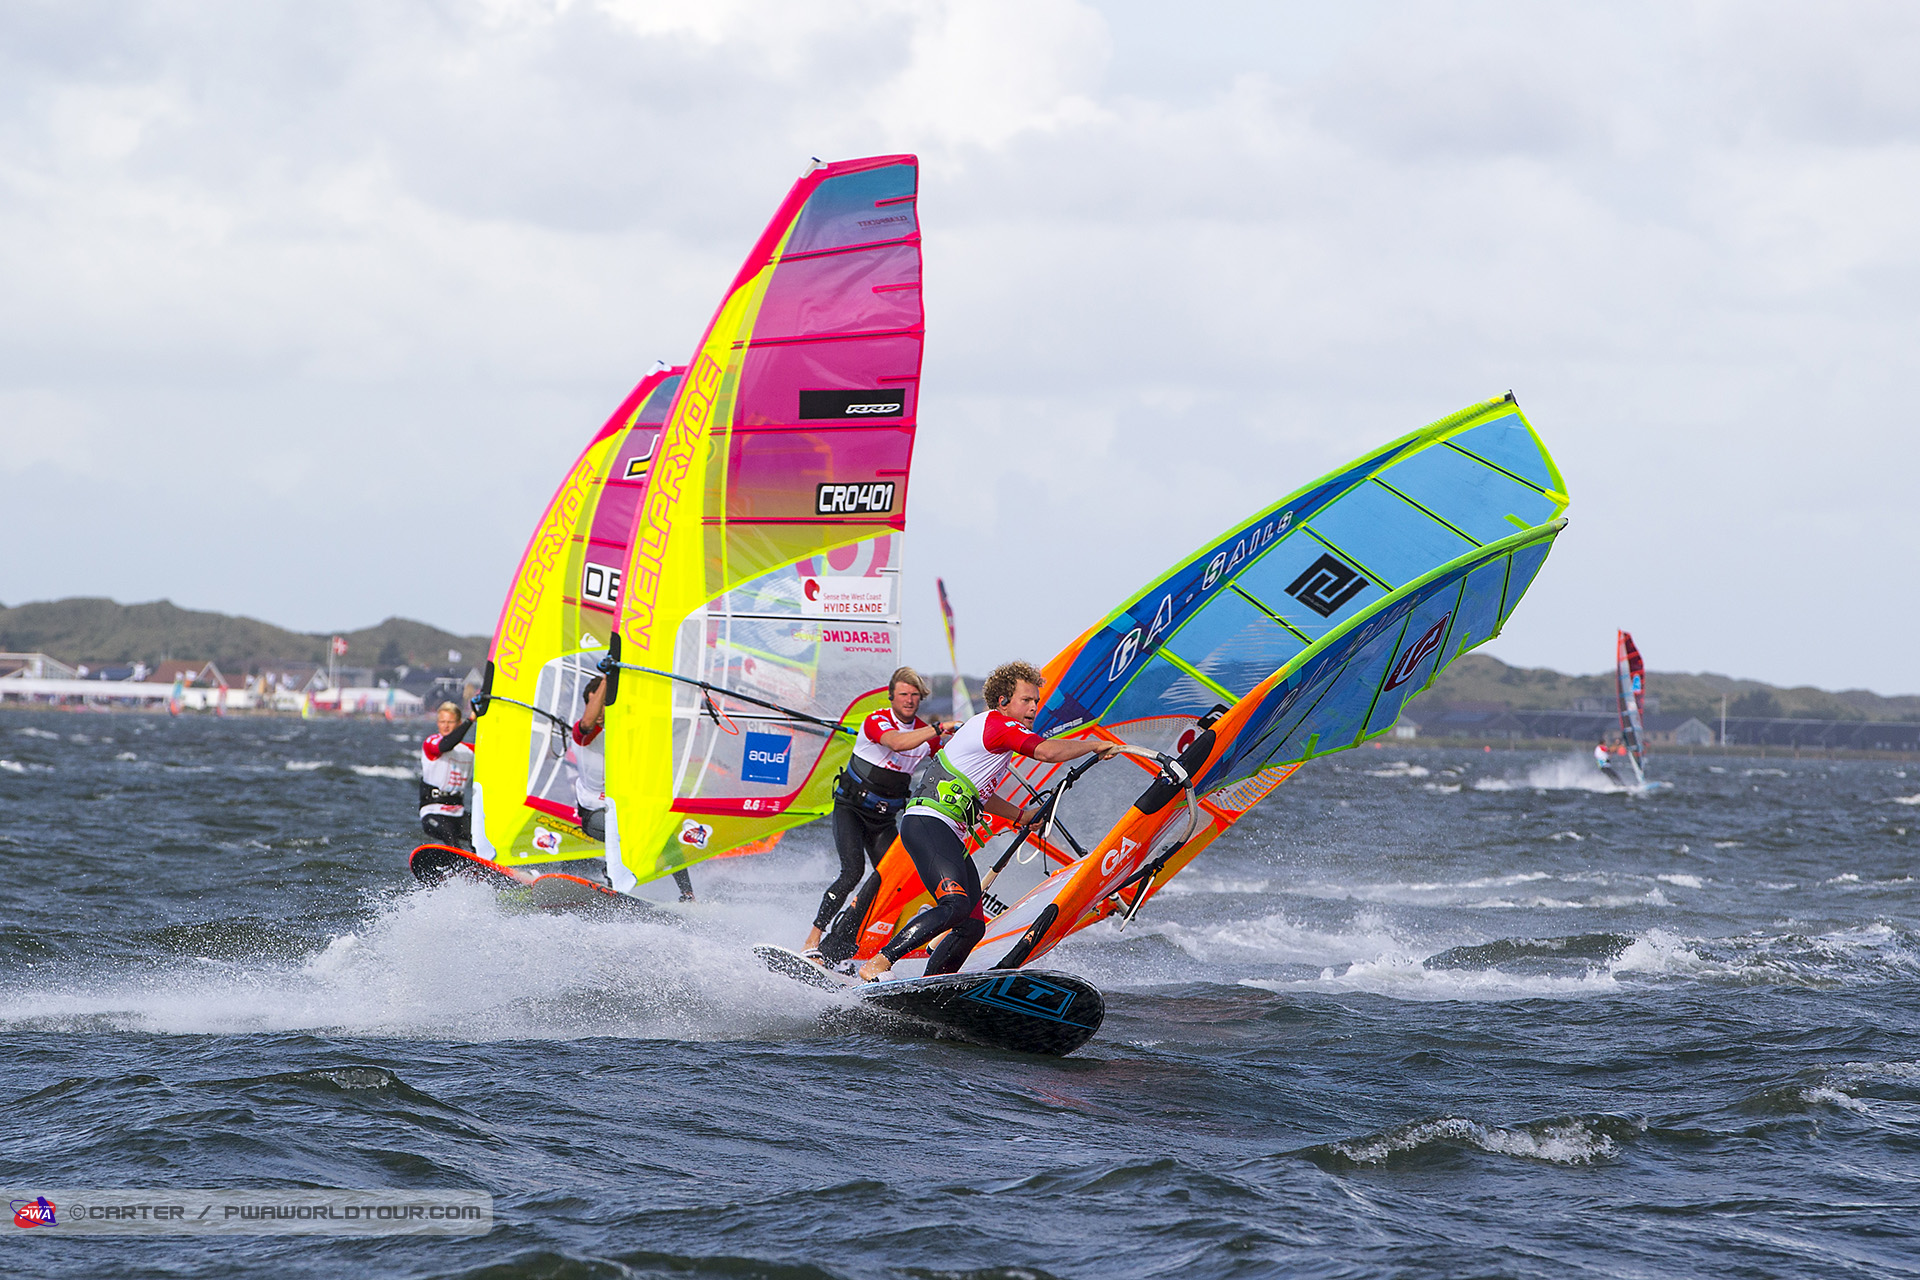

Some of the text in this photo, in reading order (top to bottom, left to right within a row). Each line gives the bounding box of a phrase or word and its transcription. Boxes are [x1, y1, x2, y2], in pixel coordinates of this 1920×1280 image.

[845, 403, 900, 414] RRD
[625, 353, 722, 651] NEILPRYDE
[819, 484, 894, 512] CRO401
[498, 459, 596, 681] NEILPRYDE
[823, 593, 882, 601] Sense the West Coast
[823, 603, 882, 613] HVIDE SANDE
[748, 750, 785, 764] aqua
[743, 799, 760, 811] 8.6
[1101, 836, 1137, 877] GA
